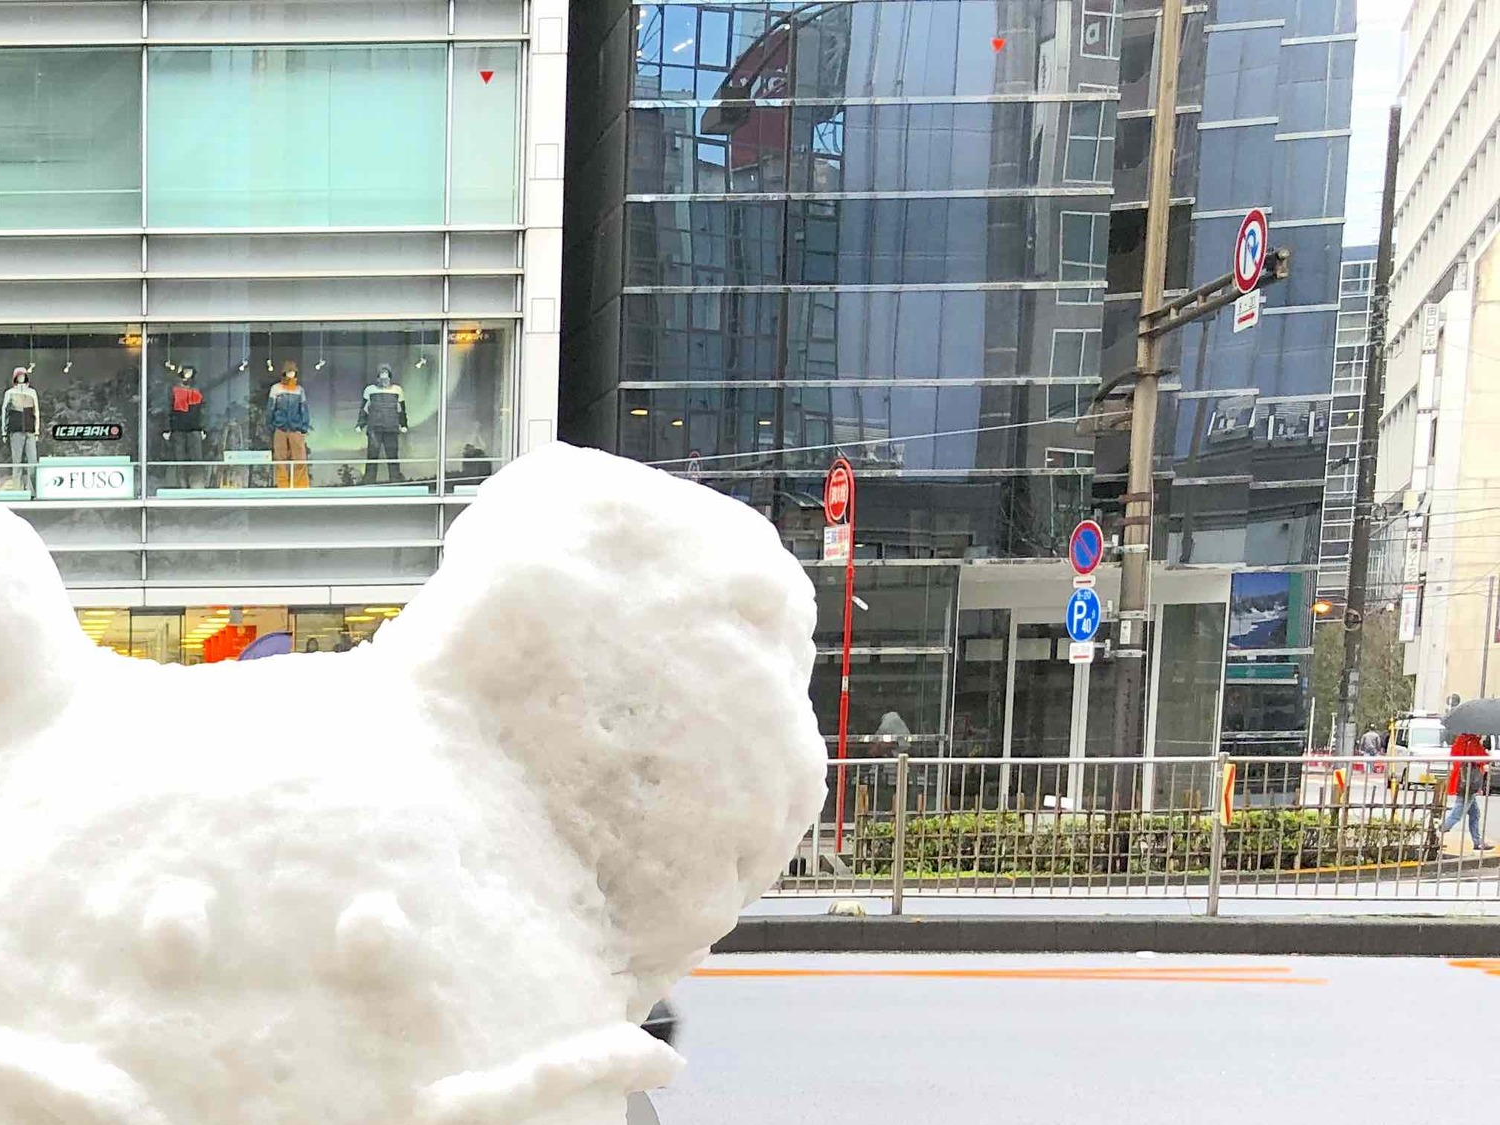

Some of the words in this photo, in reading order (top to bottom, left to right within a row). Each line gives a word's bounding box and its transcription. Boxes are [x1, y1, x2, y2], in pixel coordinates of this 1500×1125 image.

[1426, 306, 1437, 347] 田口ビル
[69, 470, 125, 489] FUSO
